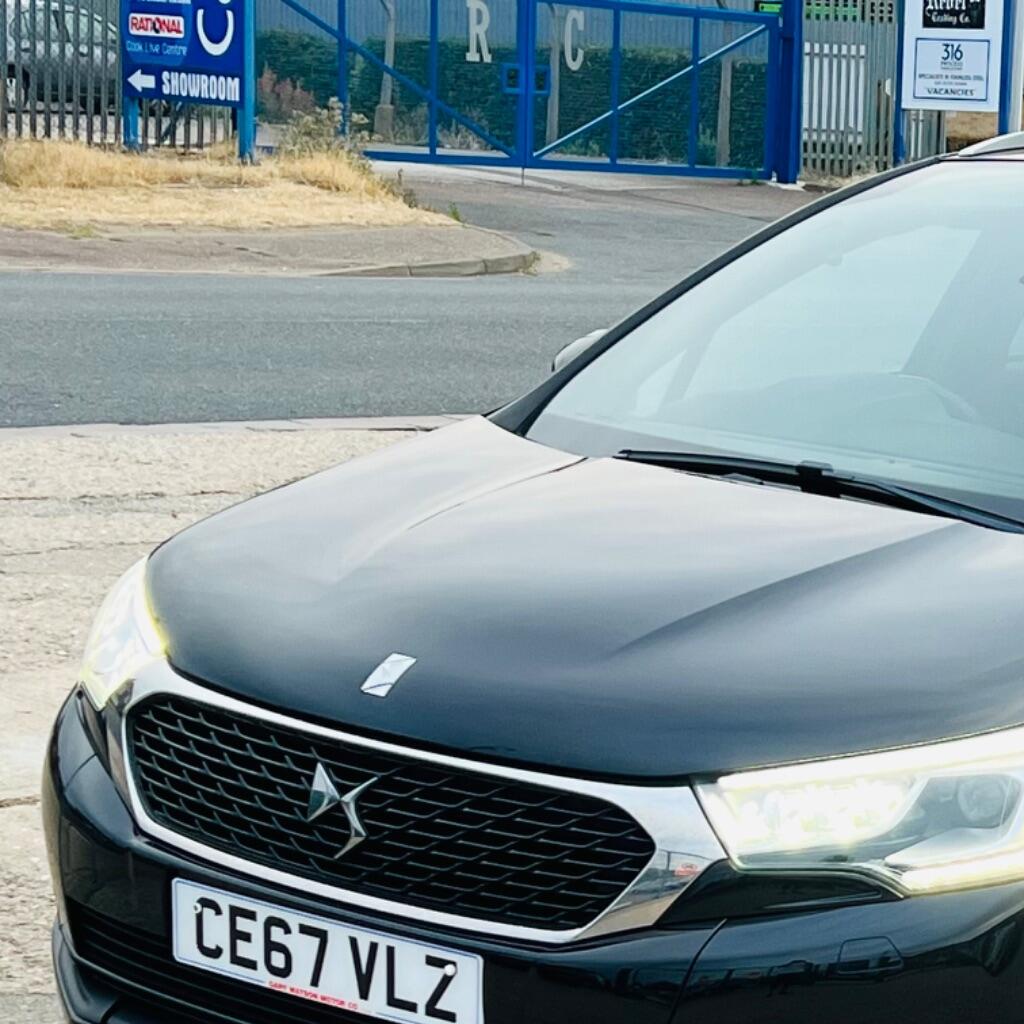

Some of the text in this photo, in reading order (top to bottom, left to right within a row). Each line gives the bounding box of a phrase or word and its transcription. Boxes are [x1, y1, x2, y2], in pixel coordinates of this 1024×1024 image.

[131, 16, 183, 34] RATIONAL
[465, 0, 585, 72] R C
[941, 43, 964, 61] 316
[162, 71, 240, 101] SHOWROOM
[193, 897, 458, 1024] CE67 VLZ
